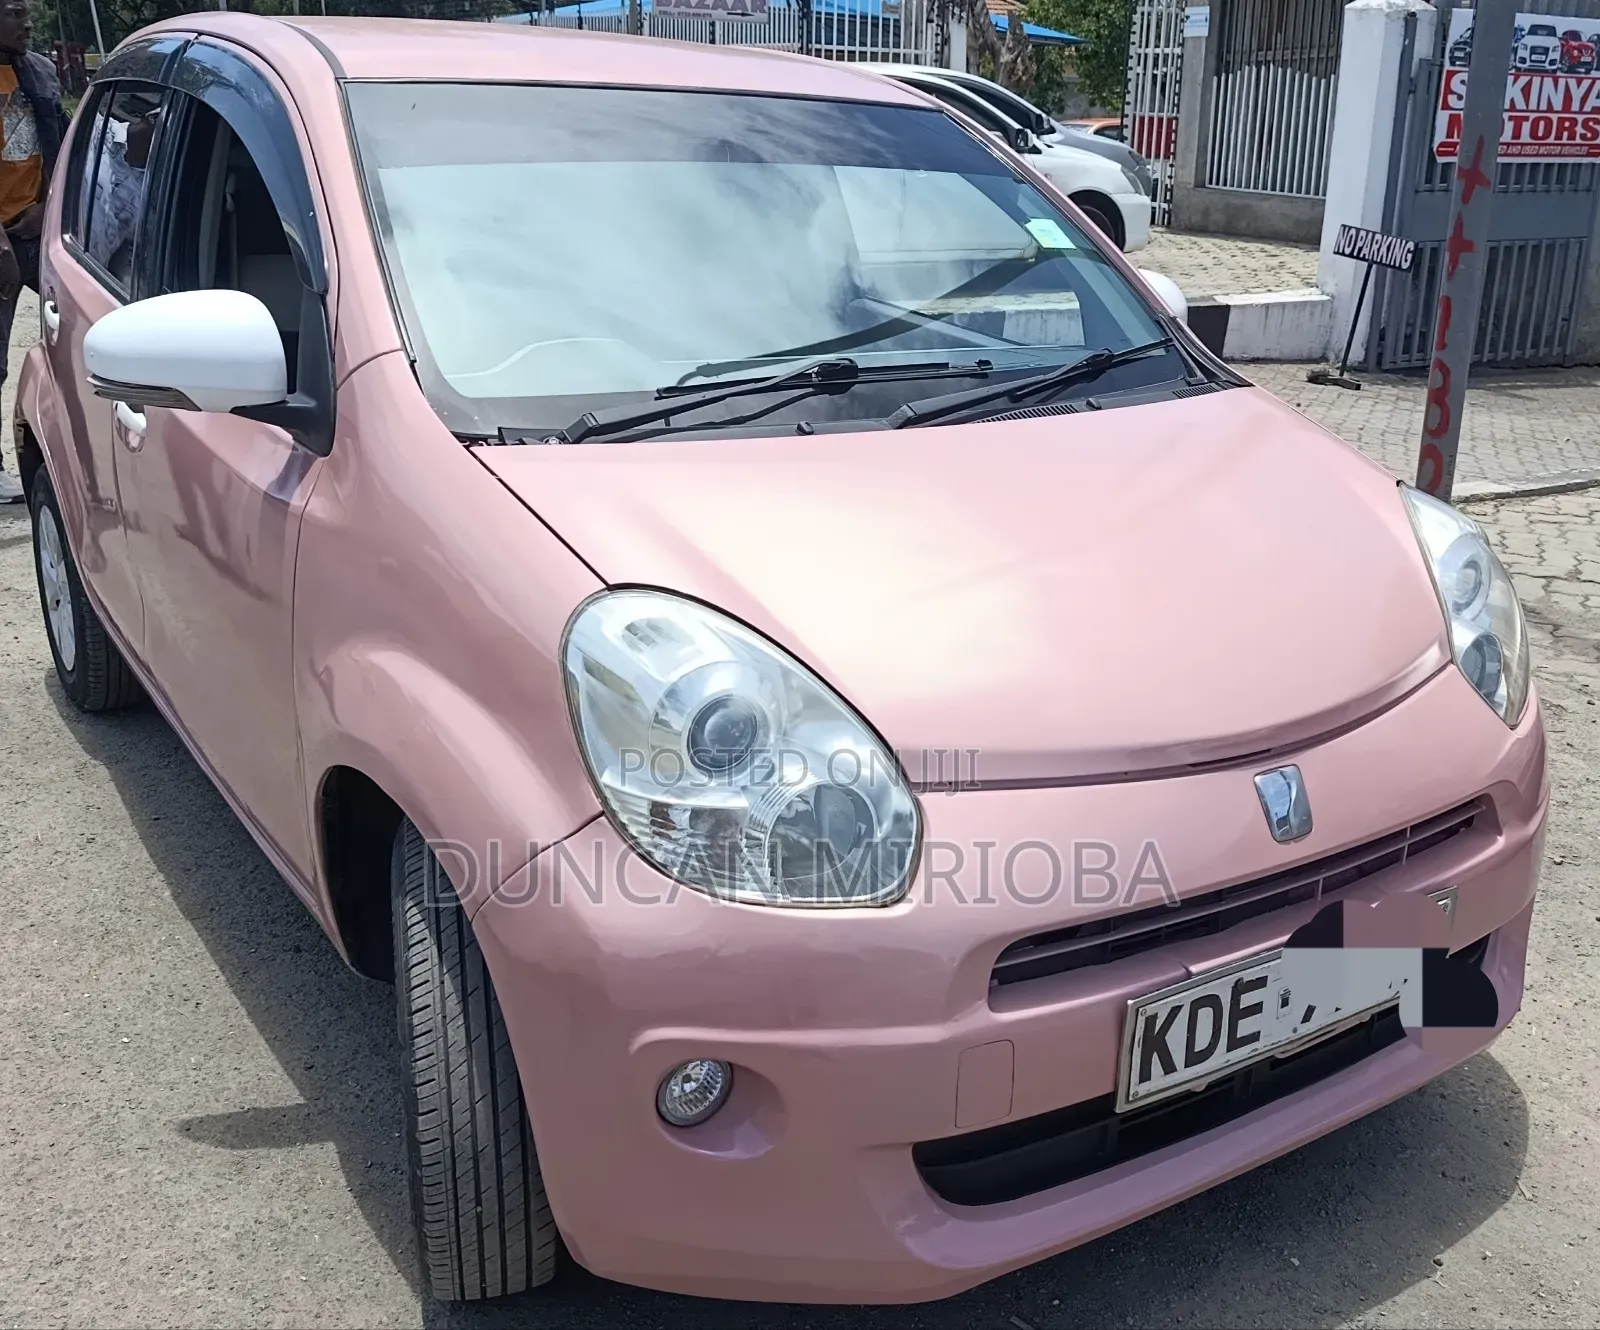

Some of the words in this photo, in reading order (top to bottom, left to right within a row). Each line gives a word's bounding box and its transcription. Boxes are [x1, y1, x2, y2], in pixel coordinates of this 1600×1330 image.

[1447, 72, 1600, 112] SKINYA
[1445, 113, 1600, 141] MTORS
[1521, 146, 1538, 154] USED
[1538, 146, 1561, 155] MOTOR
[1561, 146, 1589, 155] VEHICLES
[1335, 226, 1356, 255] NO
[1353, 230, 1415, 269] PARKING
[1139, 976, 1268, 1084] KDE
